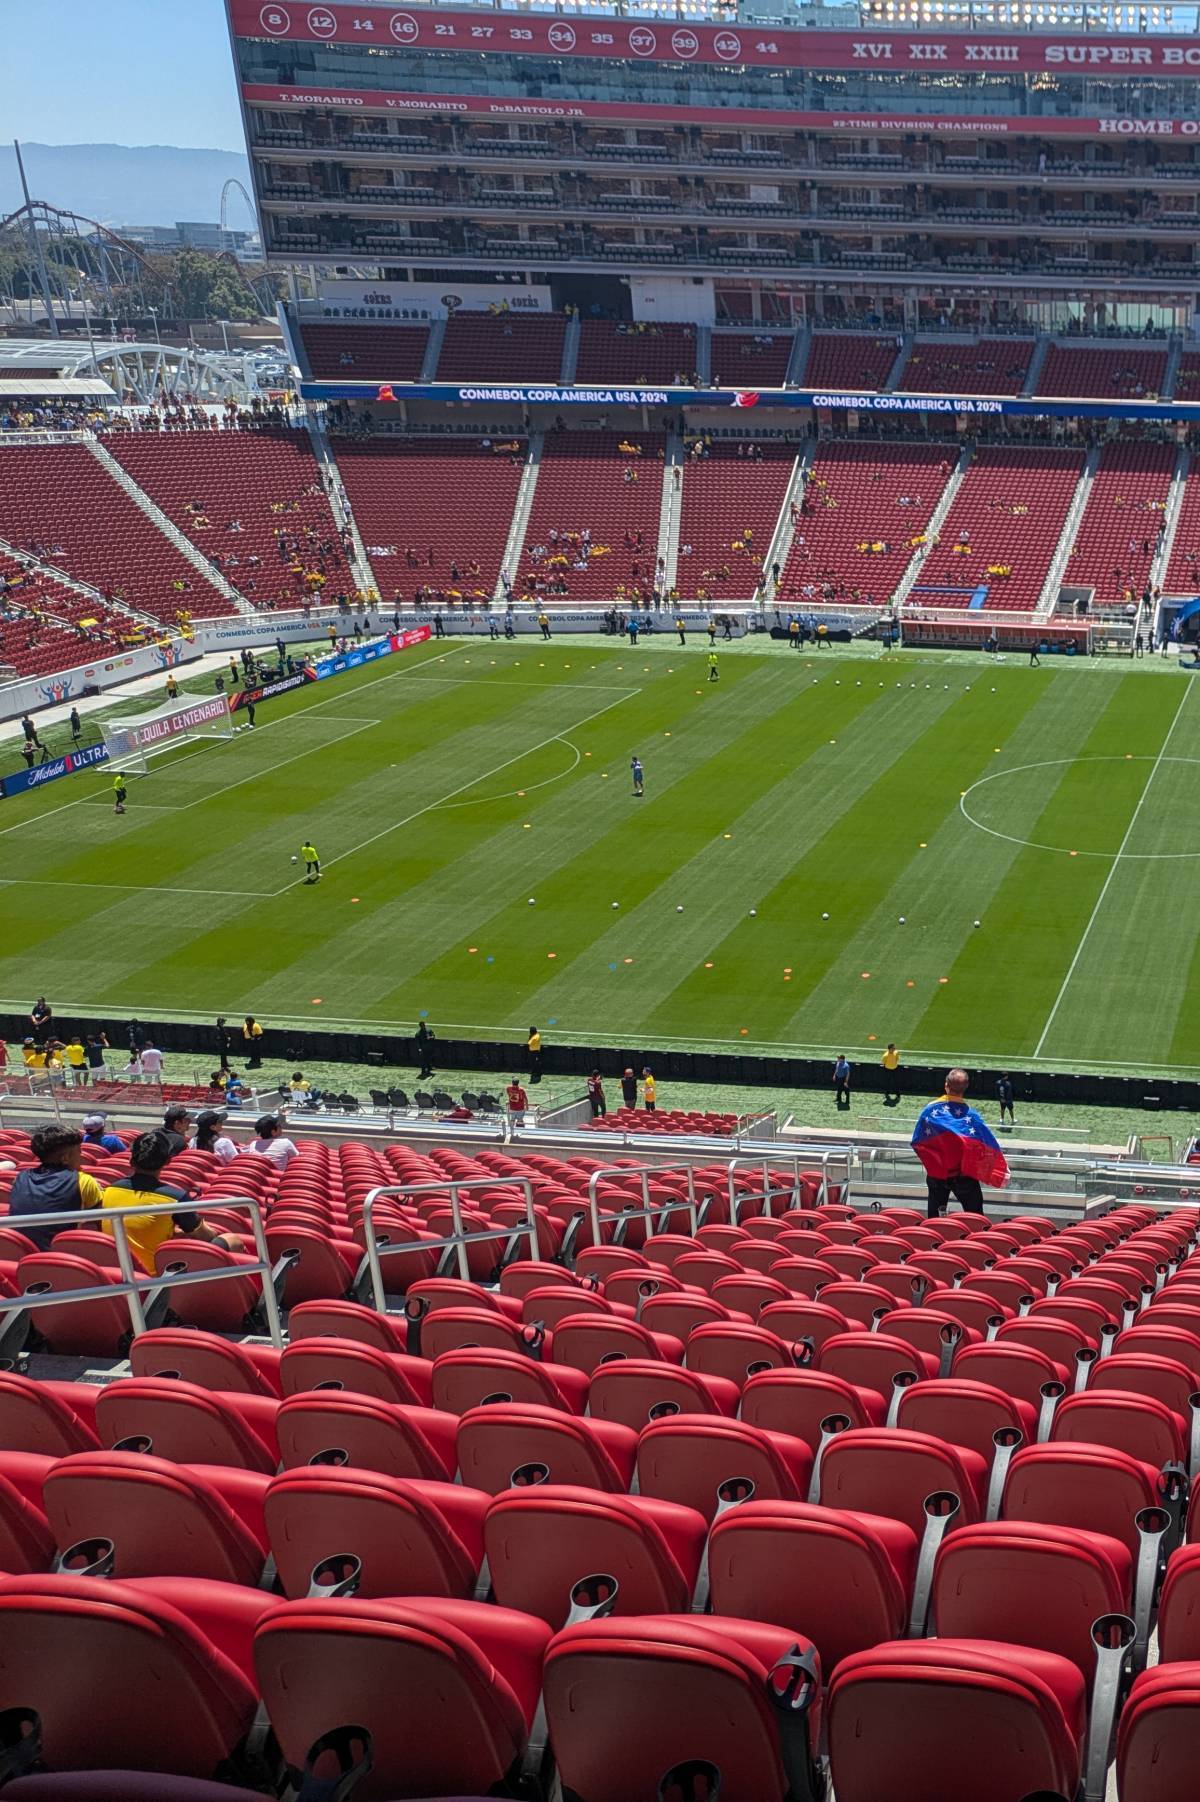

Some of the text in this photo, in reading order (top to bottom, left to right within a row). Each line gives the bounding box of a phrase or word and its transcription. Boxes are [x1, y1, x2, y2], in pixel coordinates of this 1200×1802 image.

[268, 14, 282, 25] 8
[312, 16, 332, 28] 12
[353, 19, 374, 31] 14
[394, 22, 415, 33] 16
[434, 25, 456, 36] 21
[471, 26, 494, 38] 27
[509, 29, 533, 40] 33
[550, 31, 574, 43] 34
[591, 33, 614, 45] 35
[632, 35, 653, 46] 37
[674, 37, 696, 49] 39
[716, 39, 738, 51] 42
[755, 42, 779, 54] 44
[852, 43, 1020, 62] XVI XIX XXIII
[1045, 45, 1153, 64] SUPER
[279, 93, 364, 105] T. MORABITO
[386, 100, 468, 111] V. MORABITO
[566, 108, 585, 117] JR.
[881, 121, 934, 130] DIVISION
[937, 122, 1008, 131] CHAMPIONS
[1099, 119, 1173, 134] HOME
[459, 388, 667, 403] CONMEBOL COPA AMERICA USA 2024
[813, 396, 1002, 412] CONMEBOL COPA AMERICA USA 2024
[216, 630, 256, 638] CONMEBOL
[276, 624, 306, 632] AMERICA
[172, 700, 225, 730] CENTENARIO
[28, 744, 110, 785] Michelob ULTRA
